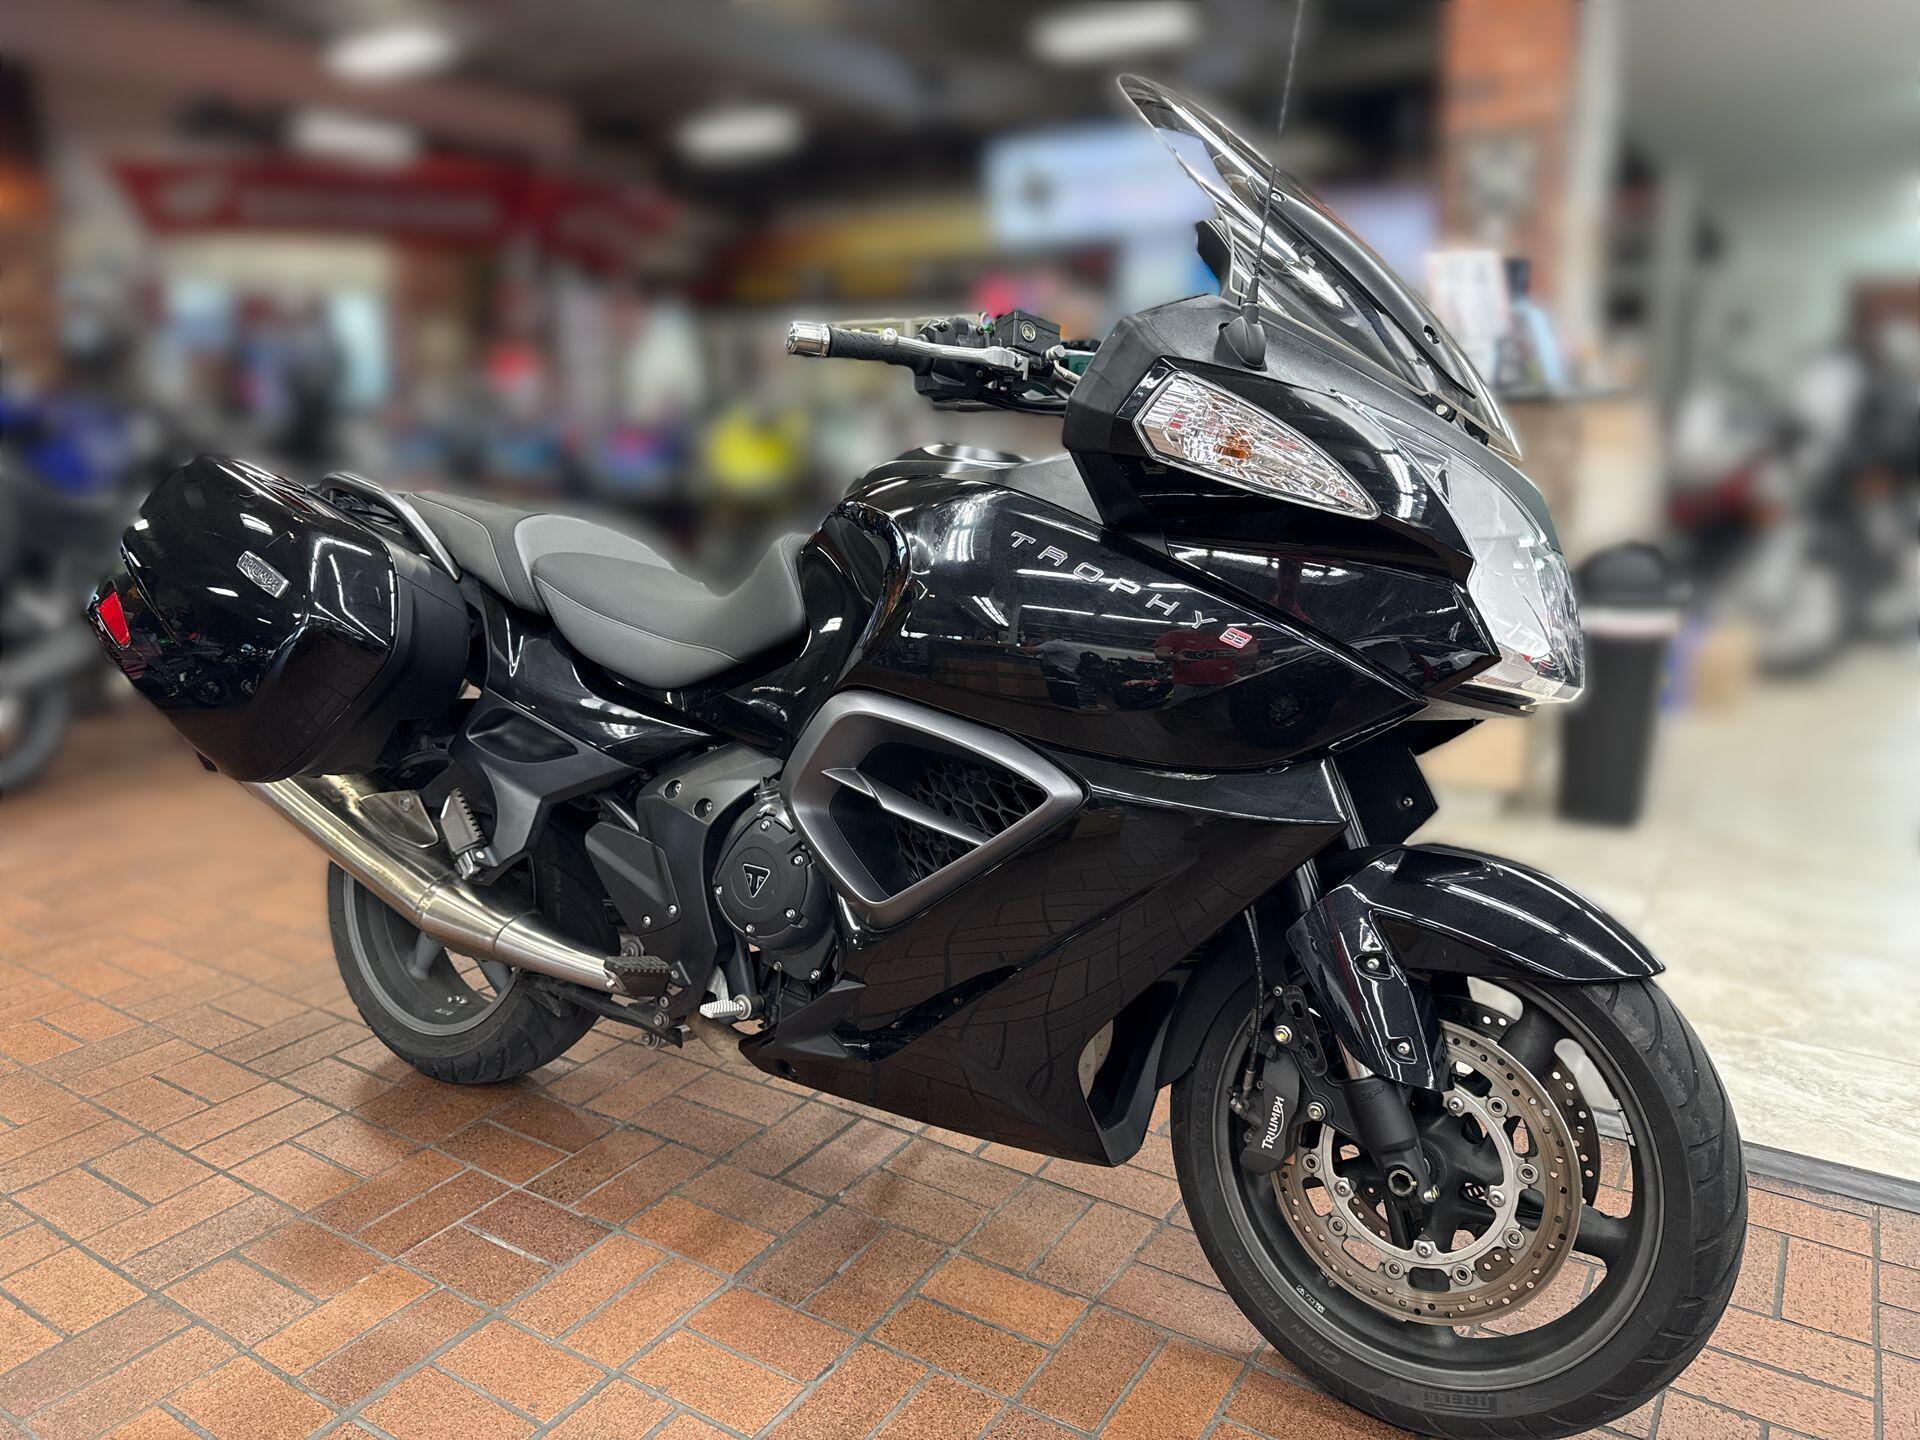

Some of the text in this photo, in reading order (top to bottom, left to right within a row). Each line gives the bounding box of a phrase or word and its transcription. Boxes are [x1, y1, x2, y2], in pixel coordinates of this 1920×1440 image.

[240, 553, 280, 592] TRIUMPH
[1010, 530, 1218, 630] TROPHY
[1261, 1095, 1285, 1151] TRIUMPH
[1422, 1390, 1498, 1415] PIRELLI
